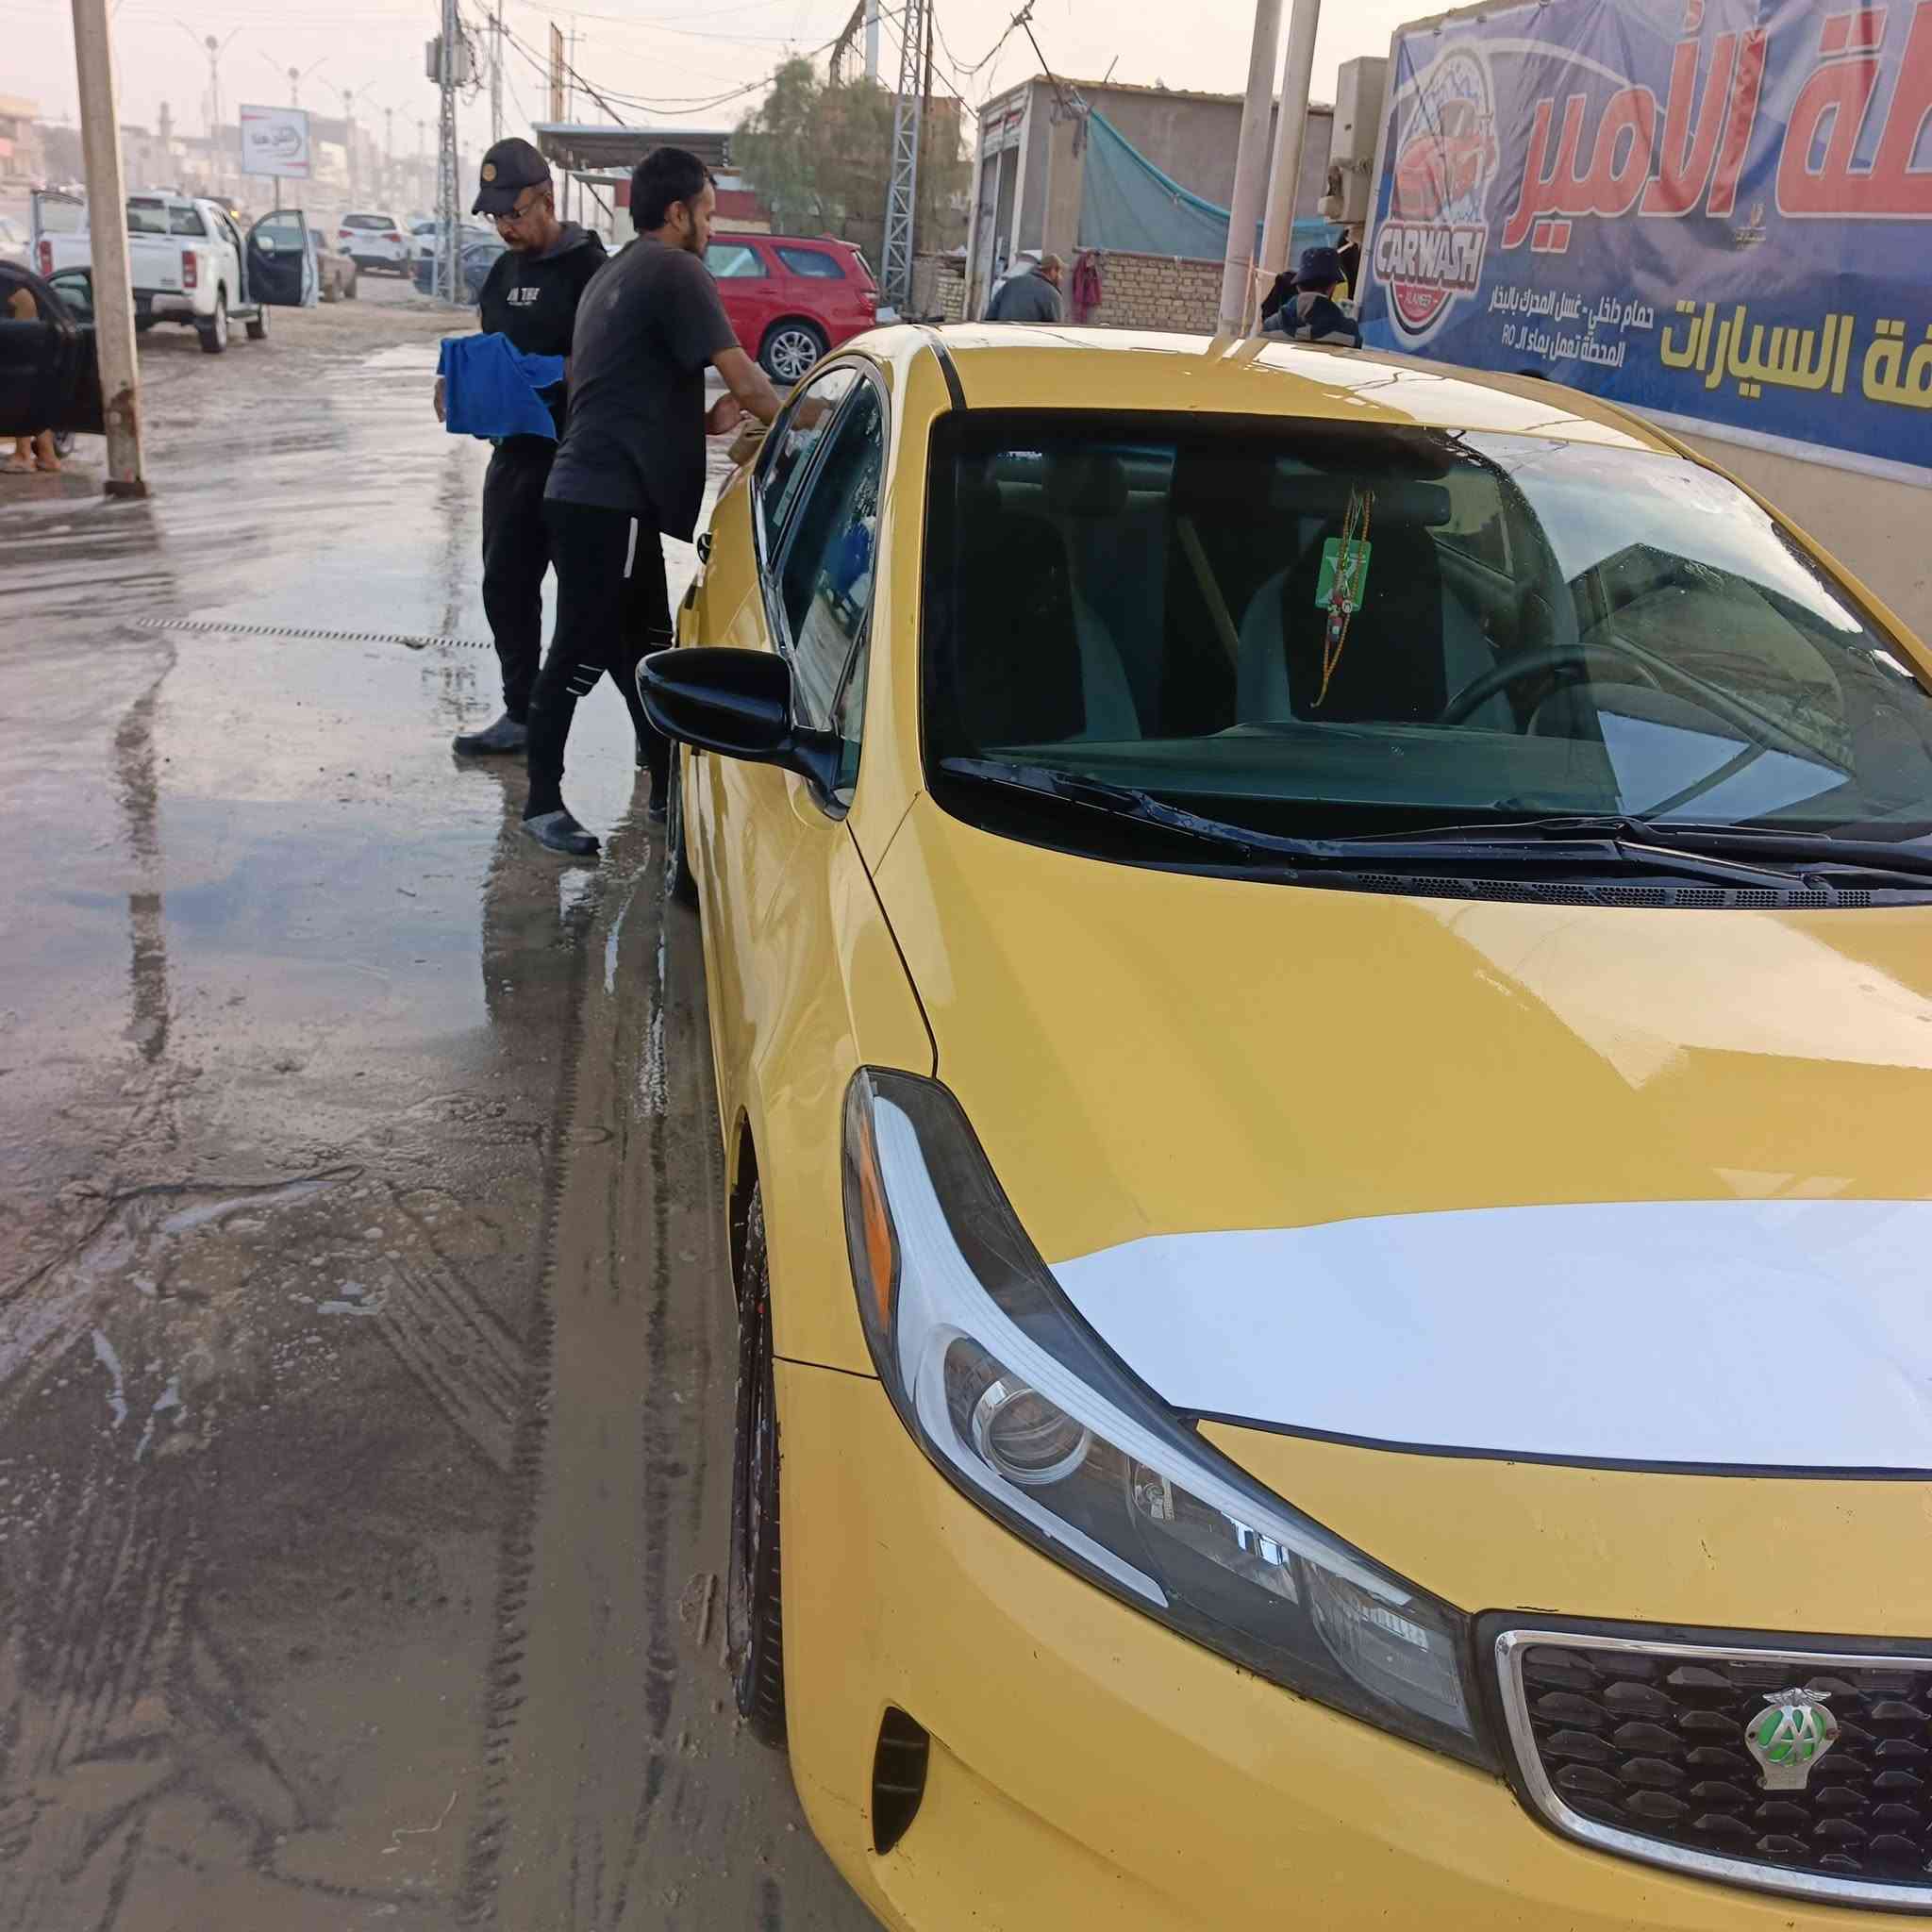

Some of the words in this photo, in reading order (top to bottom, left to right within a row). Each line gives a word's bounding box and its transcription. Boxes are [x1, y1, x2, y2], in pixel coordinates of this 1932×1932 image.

[1488, 285, 1522, 316] بالبخار
[1556, 292, 1583, 322] غسل
[1588, 296, 1622, 335] داخلي
[1621, 299, 1655, 332] حمام
[1528, 328, 1552, 359] بماء
[1549, 331, 1581, 361] تعمل
[1579, 334, 1626, 368] المحطة
[1659, 299, 1855, 398] السيارات
